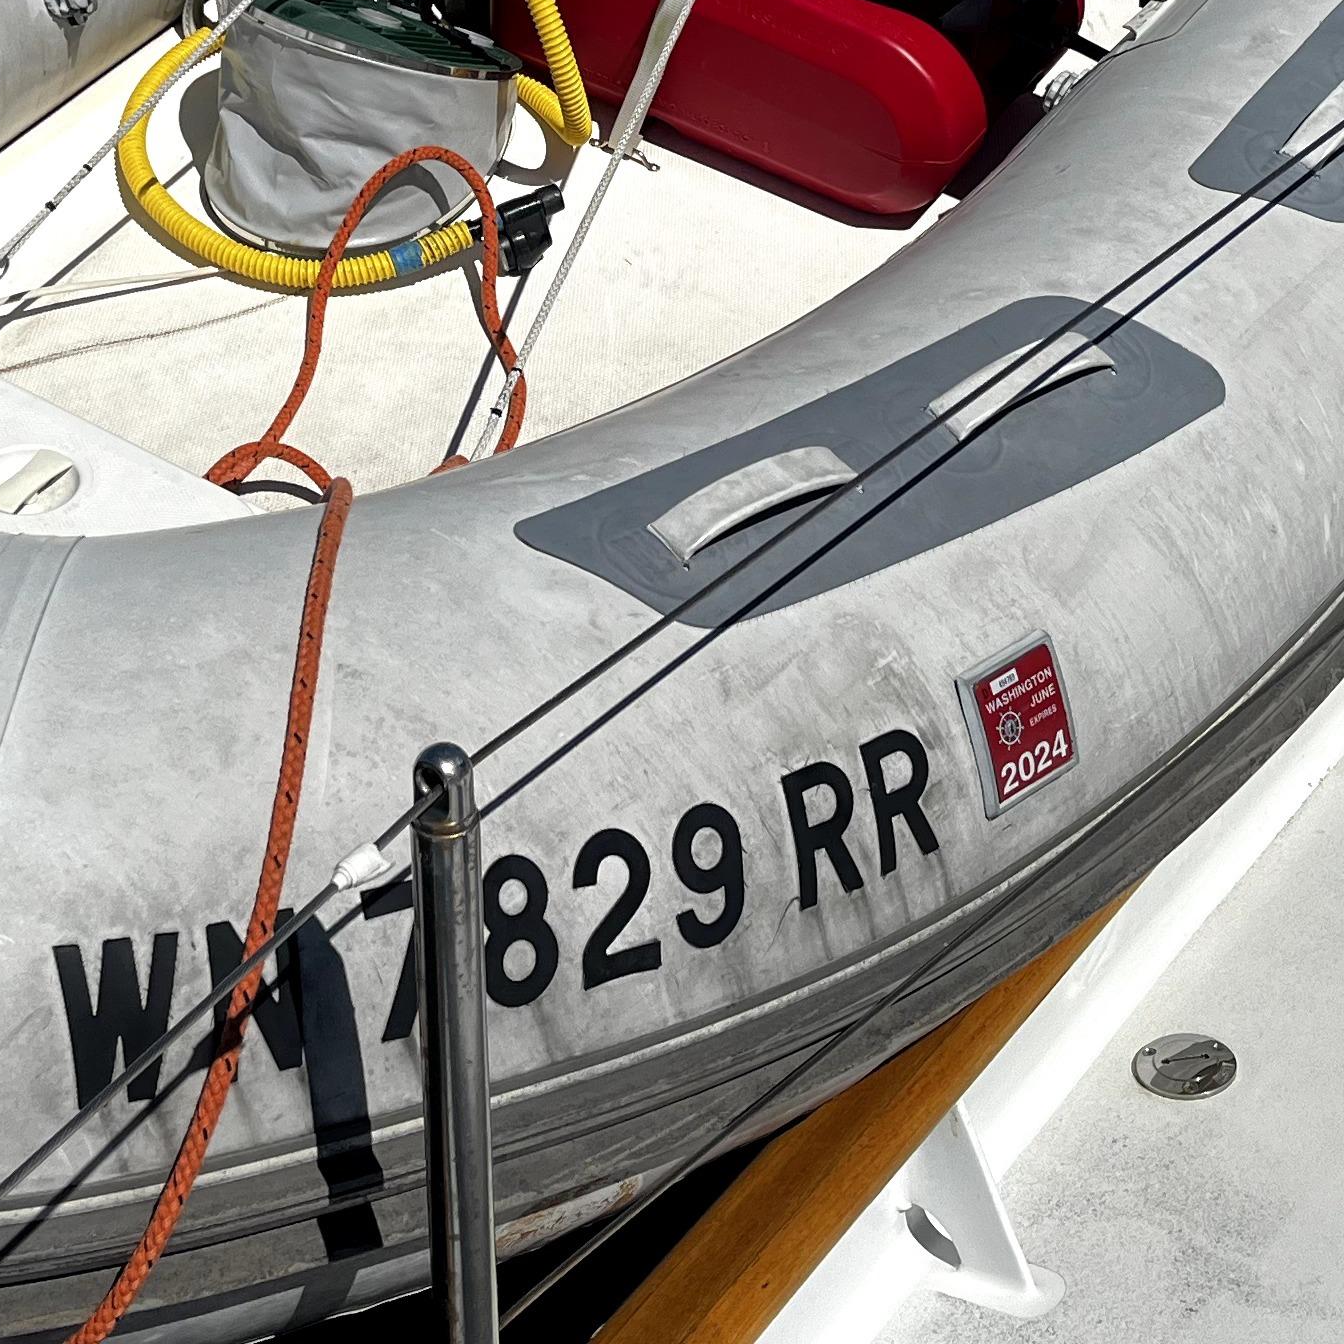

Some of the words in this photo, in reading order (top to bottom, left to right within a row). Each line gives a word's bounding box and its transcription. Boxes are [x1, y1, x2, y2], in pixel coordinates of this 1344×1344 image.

[985, 667, 1052, 714] WASHINGTON
[1030, 683, 1056, 707] JUNE
[1029, 703, 1058, 727] EXPIRES
[1001, 729, 1068, 795] 2024
[54, 908, 306, 1109] WN
[360, 803, 744, 1043] 7829
[780, 728, 940, 911] RR
